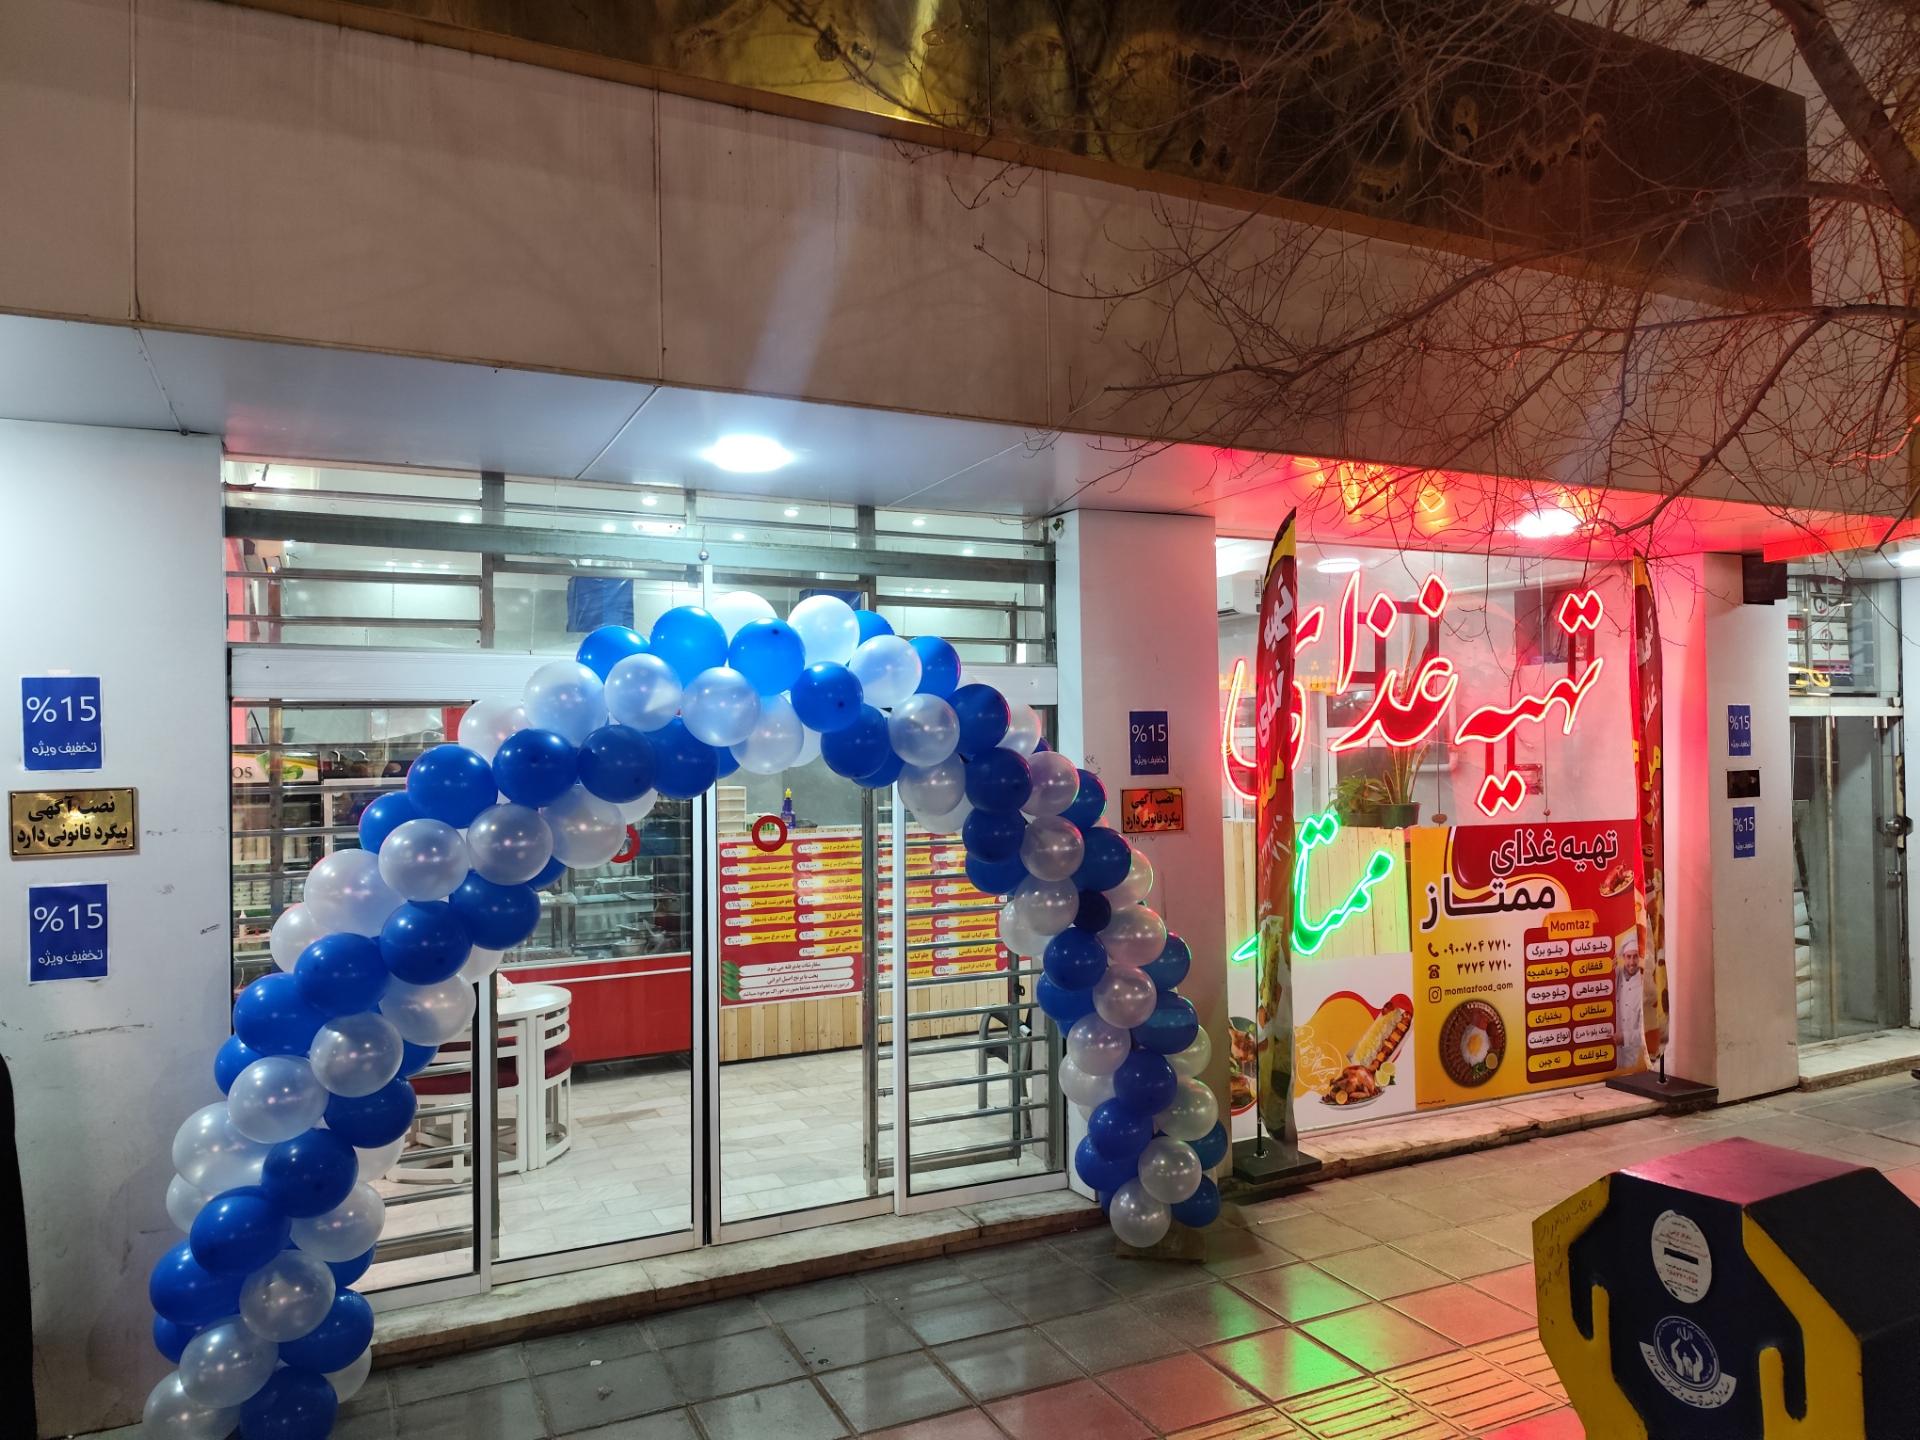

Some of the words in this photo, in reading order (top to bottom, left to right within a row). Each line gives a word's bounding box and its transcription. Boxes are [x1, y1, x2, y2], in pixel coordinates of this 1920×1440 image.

[1454, 590, 1605, 817] تهیه
[31, 740, 58, 757] ویژه
[58, 739, 98, 756] تخفیف
[28, 795, 74, 822] آگهی
[78, 795, 115, 818] نصب
[17, 825, 46, 849] دارد
[47, 822, 91, 848] قانونی
[1490, 829, 1558, 877] غذای
[1561, 829, 1619, 872] تهیه
[1421, 874, 1556, 931] ممتاز
[1550, 920, 1590, 933] Momtaz
[1488, 939, 1511, 951] ۷۷۱۰
[1575, 941, 1592, 953] کباب
[37, 950, 65, 967] ویژه
[64, 949, 105, 965] تخفیف
[1531, 947, 1546, 957] برگ
[1457, 961, 1486, 976] ۳۷۷۴
[1489, 959, 1512, 972] ۷۷۱۰
[1527, 968, 1553, 979] ماهیچه
[1555, 966, 1569, 977] چلو
[1444, 982, 1514, 996] momtazfood_qom
[1552, 988, 1567, 999] چلو
[1576, 985, 1595, 997] ماهی
[1595, 983, 1610, 994] چلو
[1531, 991, 1551, 1002] جوجه
[1535, 1010, 1562, 1024] بختیاری
[1579, 1005, 1607, 1018] سلطانی
[1529, 1034, 1556, 1045] خورشت
[1556, 1030, 1571, 1043] انواع
[1575, 1030, 1585, 1039] مرغ
[1578, 1050, 1595, 1060] لقمه
[1595, 1049, 1609, 1059] چلو
